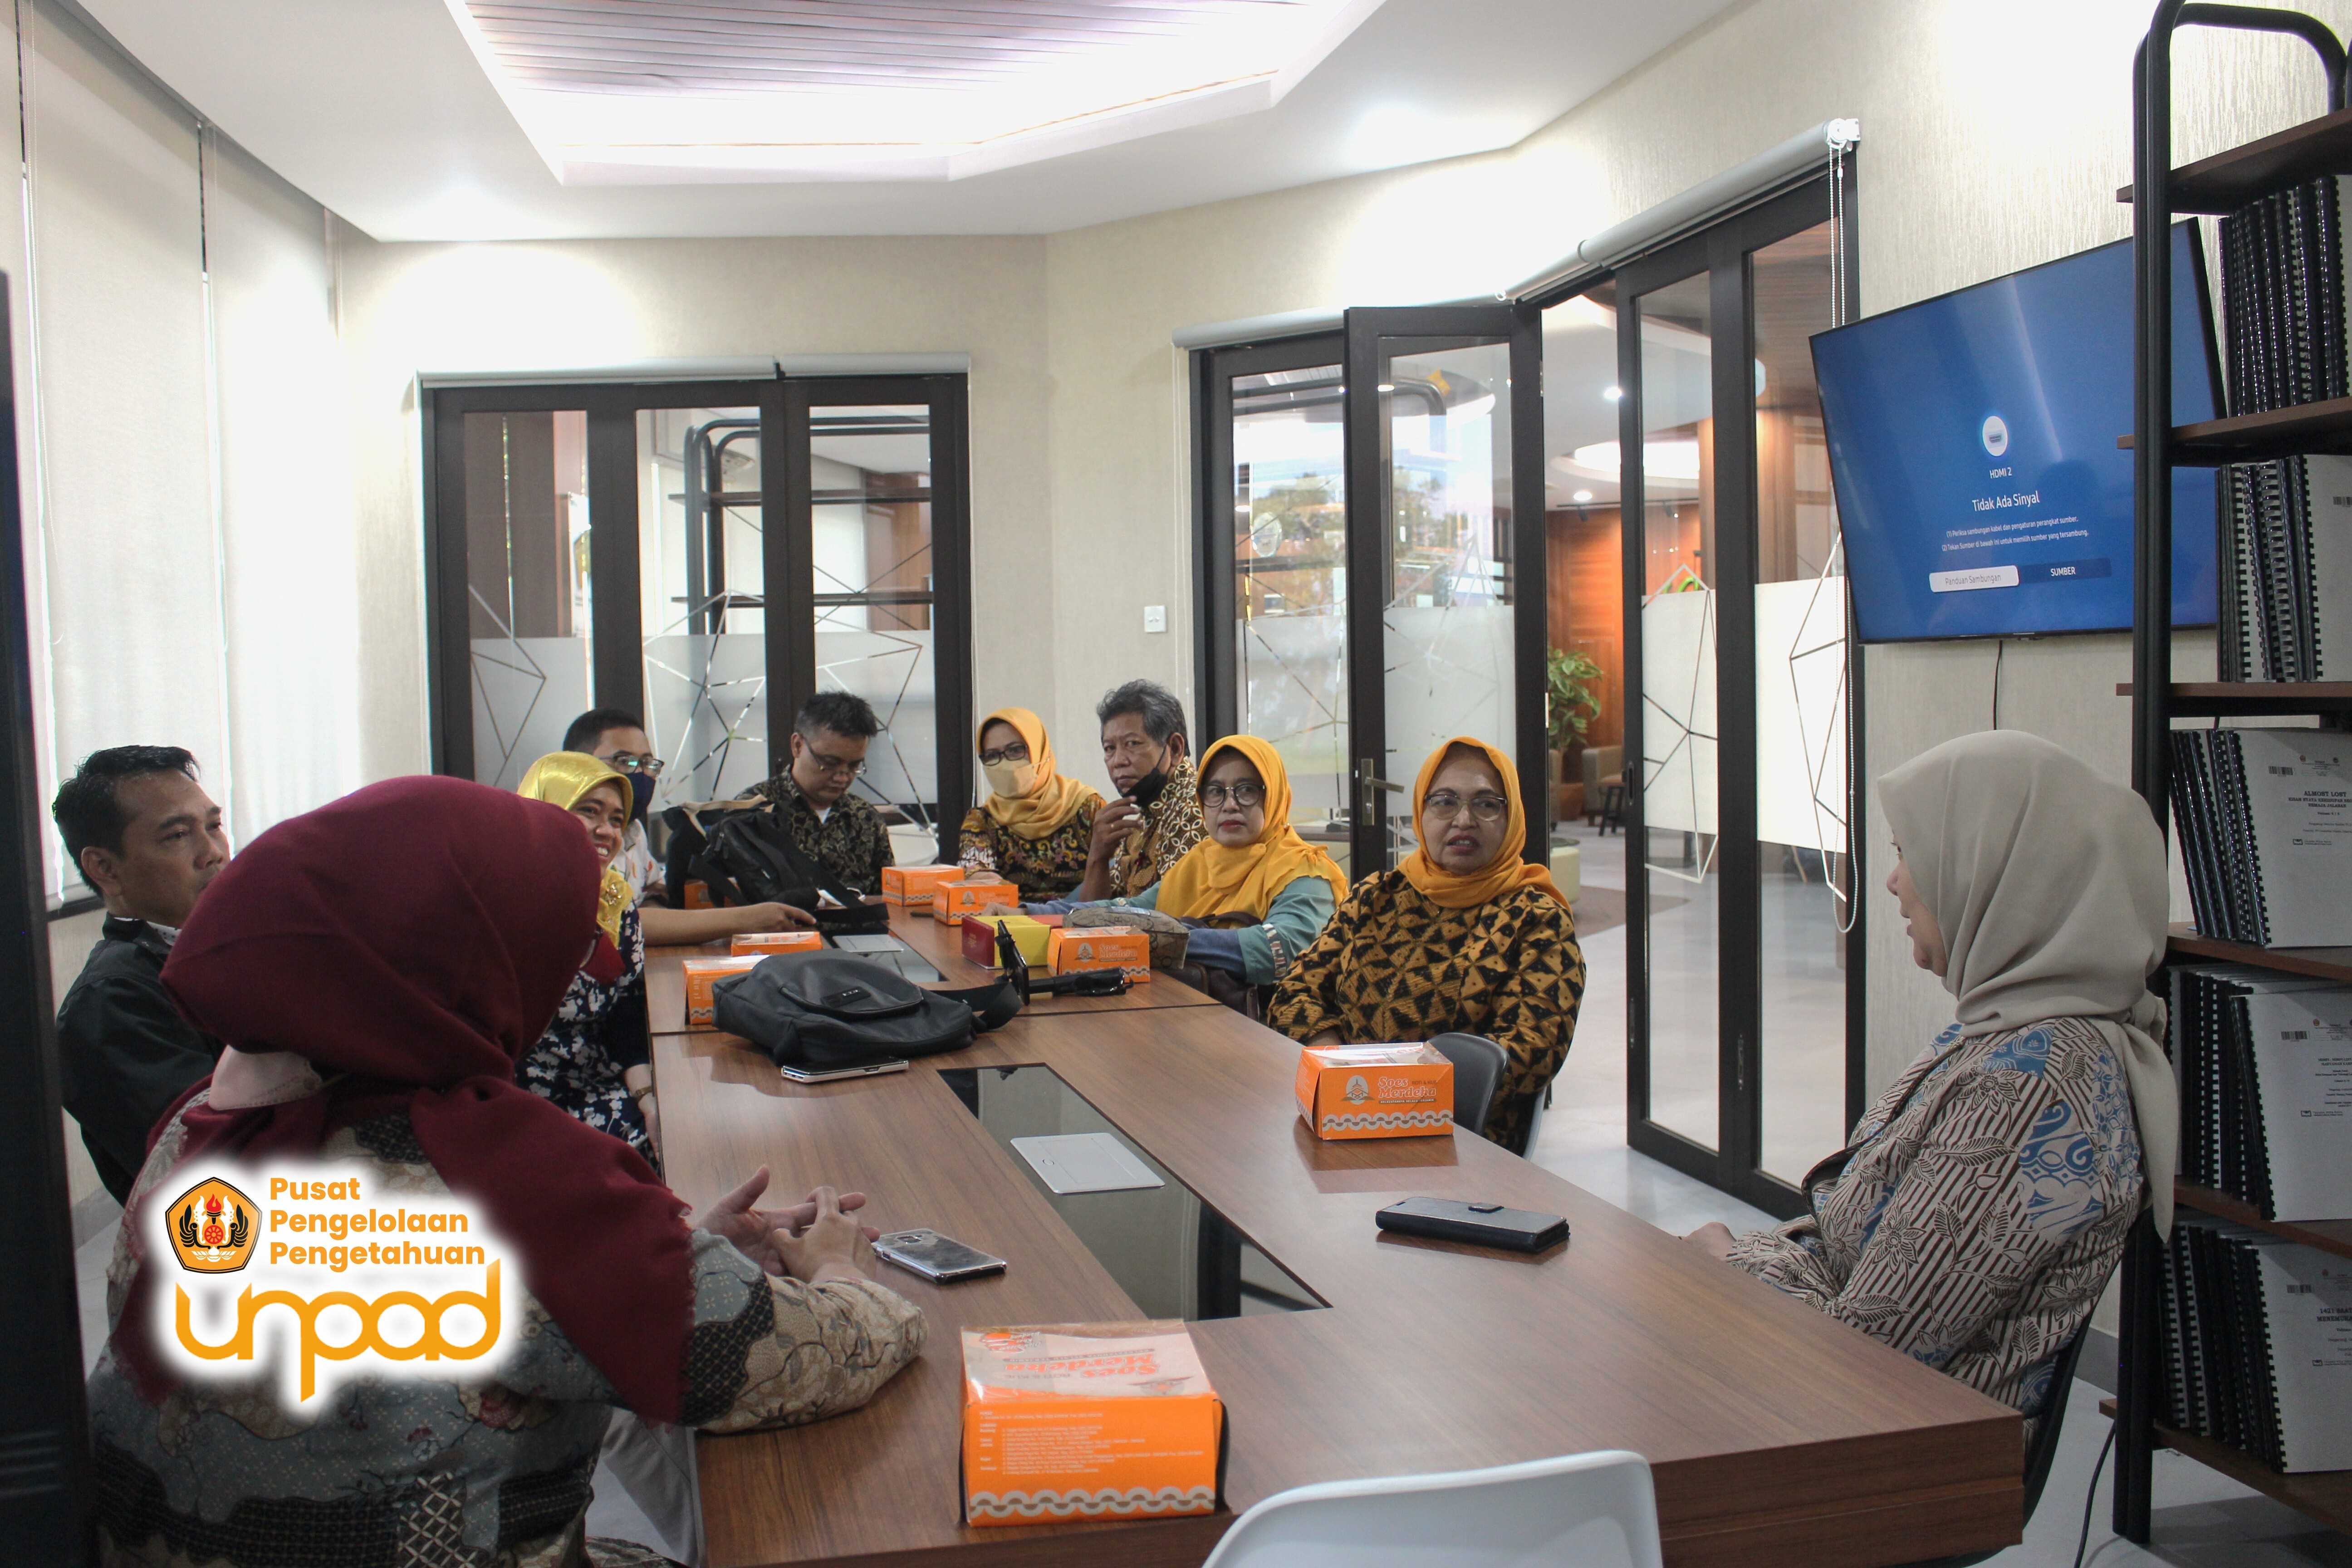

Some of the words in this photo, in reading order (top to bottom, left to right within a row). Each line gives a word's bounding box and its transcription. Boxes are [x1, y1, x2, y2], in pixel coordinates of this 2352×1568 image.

[1989, 468, 2006, 479] HDMI
[2007, 467, 2012, 476] 2
[1972, 497, 1995, 512] Tidak
[1996, 495, 2012, 509] Ada
[2013, 490, 2040, 507] Sinyal
[2011, 521, 2036, 530] pengaturan
[2036, 518, 2059, 528] perangkat
[2051, 567, 2076, 576] SUMBER
[1945, 577, 1968, 585] Panduan
[1969, 573, 2001, 584] Sambungan
[1378, 1076, 1408, 1088] Soes
[1378, 1086, 1437, 1098] Merdeka
[1005, 1353, 1153, 1373] Merdeka
[1082, 1363, 1158, 1378] Soes
